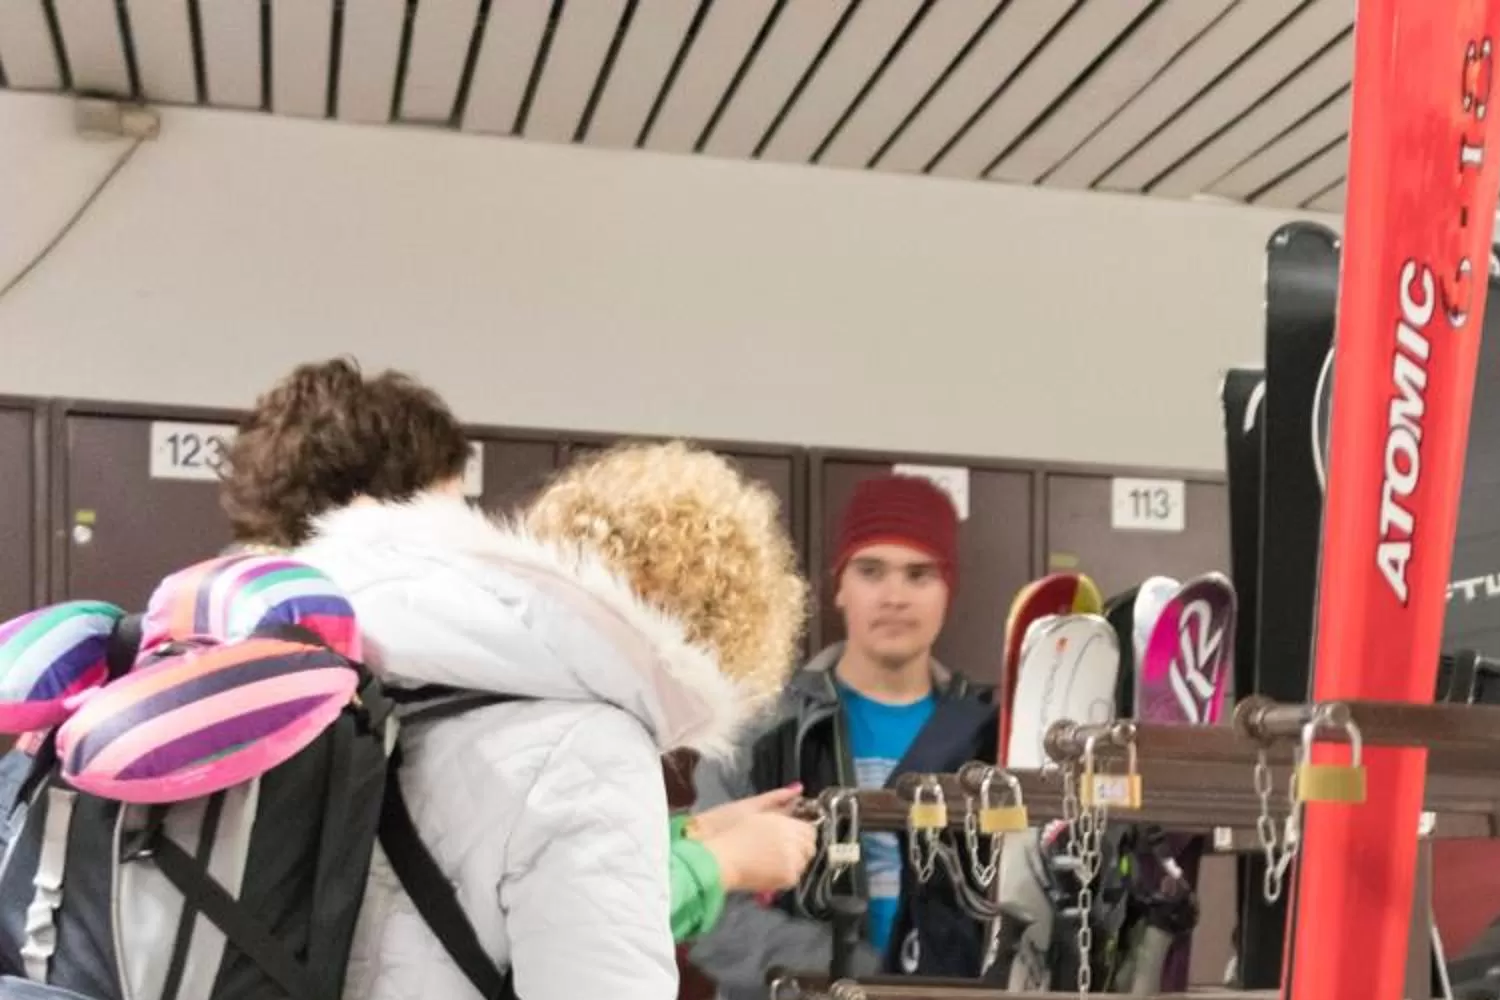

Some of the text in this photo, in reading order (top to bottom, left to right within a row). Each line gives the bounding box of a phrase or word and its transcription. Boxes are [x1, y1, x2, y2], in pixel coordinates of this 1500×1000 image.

[1376, 257, 1436, 603] ATOMIC
[167, 433, 227, 469] 123
[1128, 487, 1171, 521] 113
